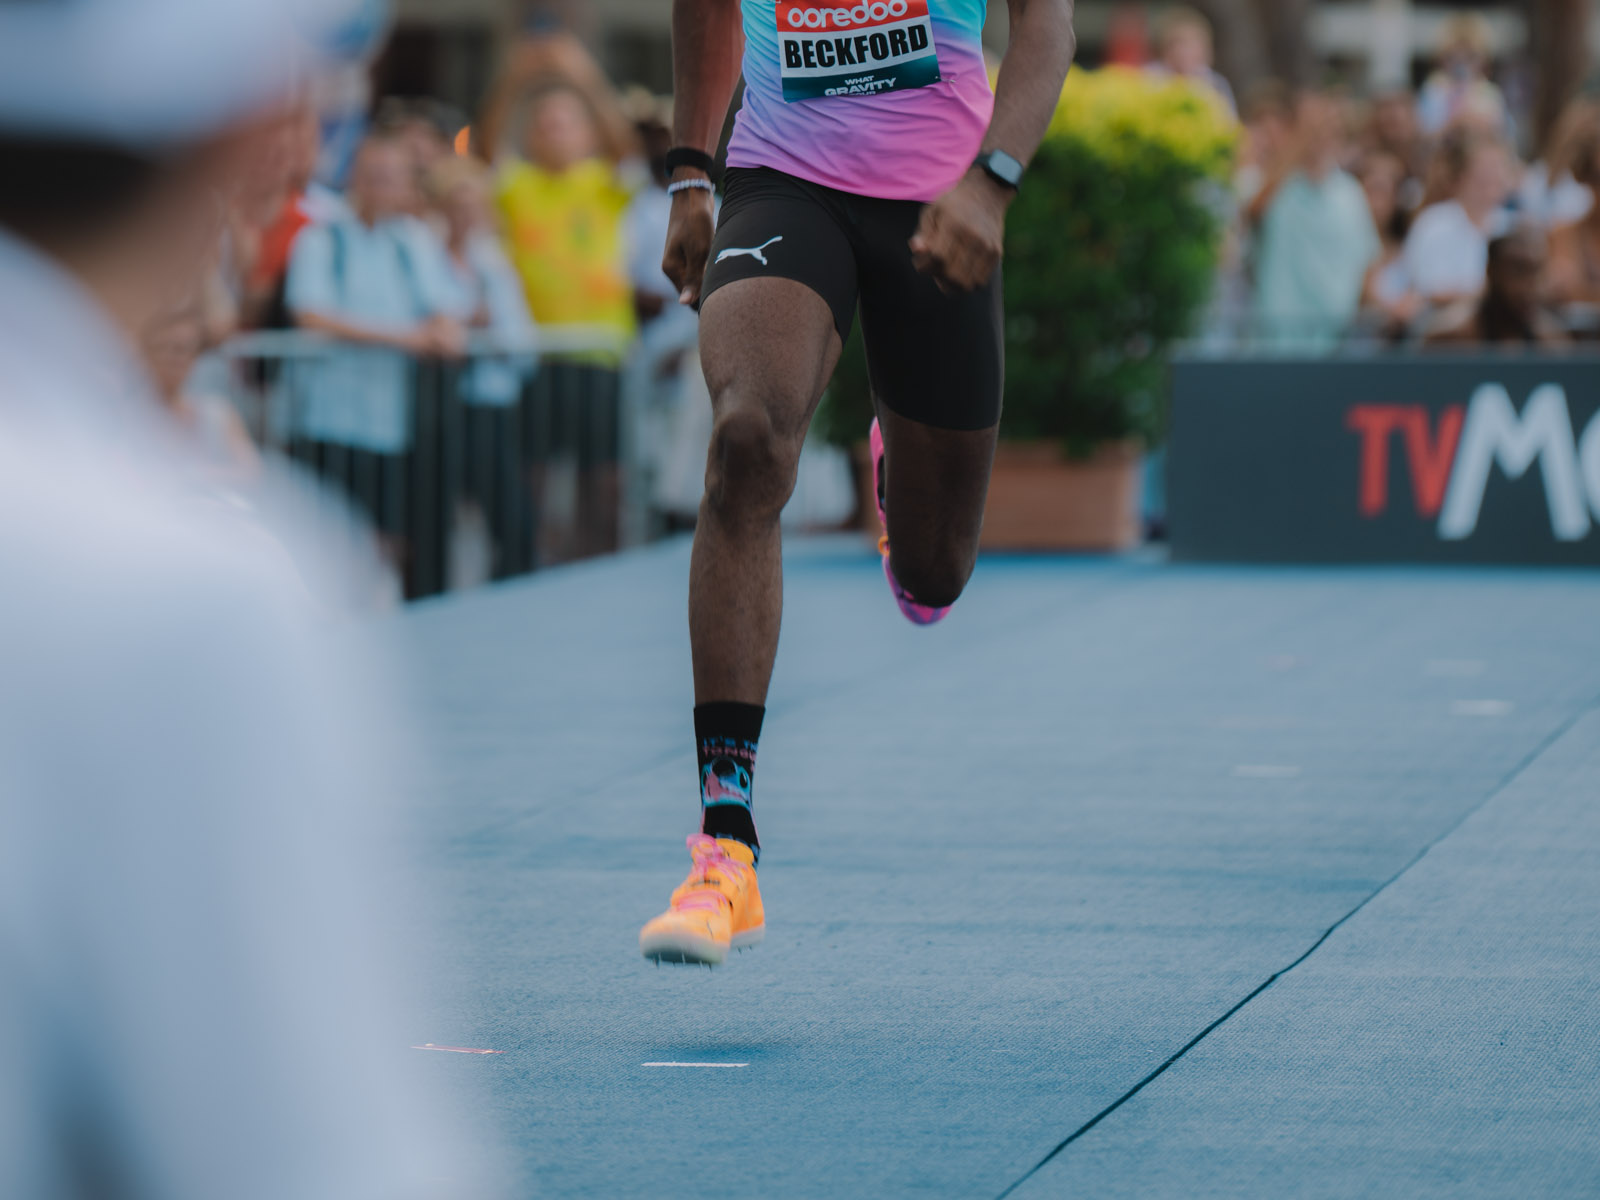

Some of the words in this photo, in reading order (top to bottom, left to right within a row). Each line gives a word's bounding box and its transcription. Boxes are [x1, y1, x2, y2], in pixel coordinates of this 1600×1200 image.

[784, 24, 928, 68] BECKFORD
[824, 77, 897, 96] GRAVITY
[844, 75, 875, 86] WHAT
